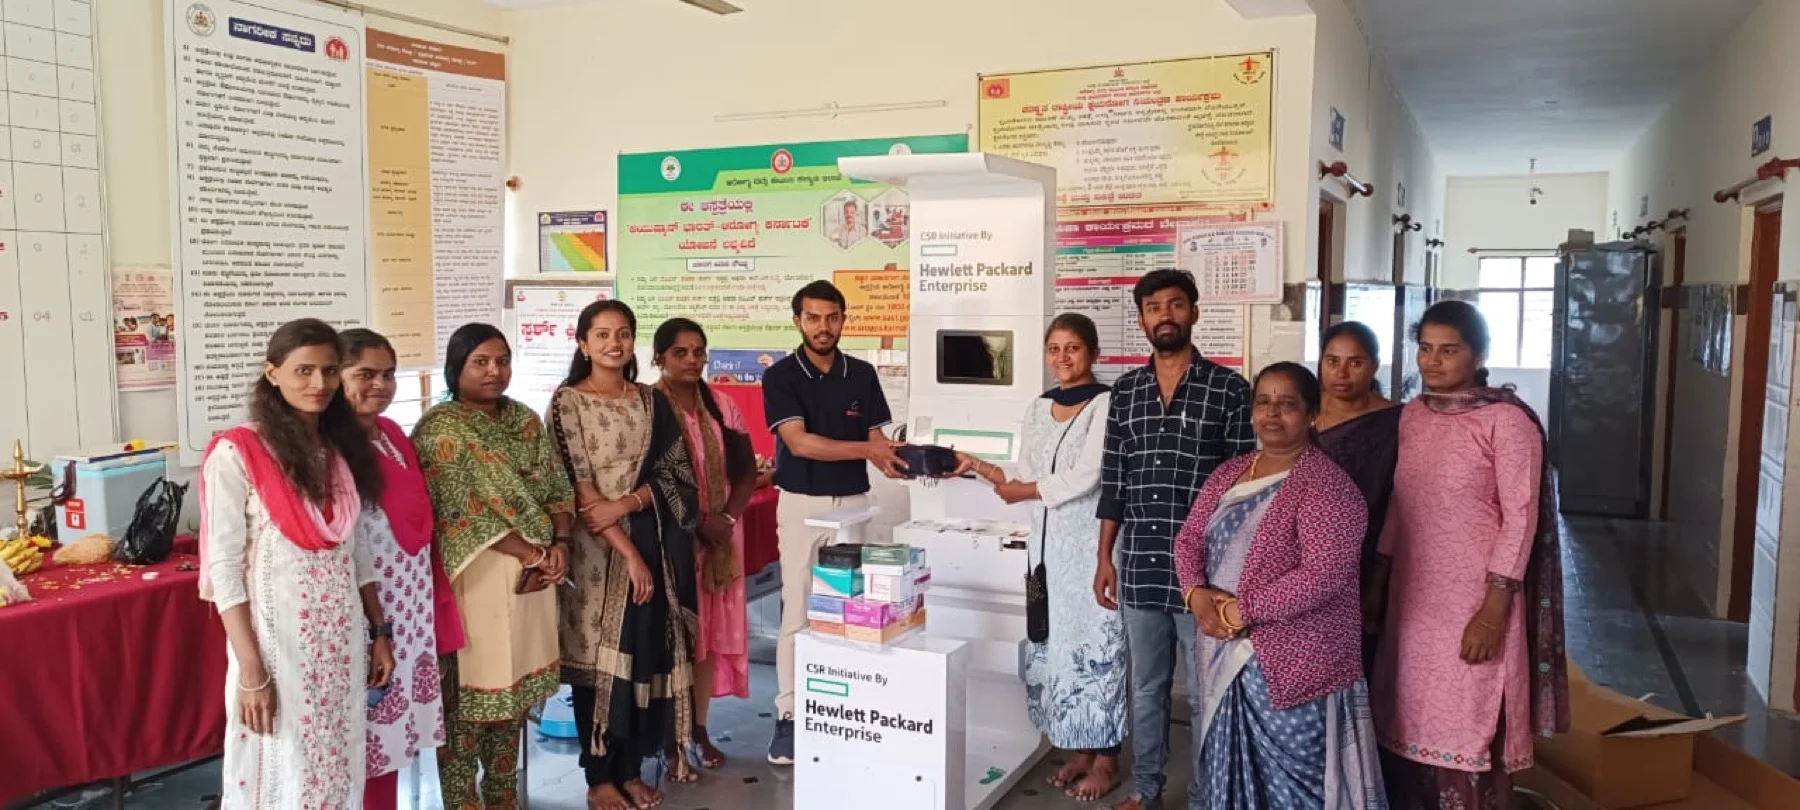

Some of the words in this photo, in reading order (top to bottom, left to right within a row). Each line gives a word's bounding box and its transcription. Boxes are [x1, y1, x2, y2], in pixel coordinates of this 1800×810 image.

[700, 198, 753, 216] ಆಸ್ಪತ್ರೆಯಲ್ಲಿ
[920, 231, 937, 241] CSR
[939, 230, 979, 240] Initiative
[981, 230, 992, 241] By
[920, 263, 973, 277] Hewlett
[977, 261, 1032, 276] Packard
[920, 278, 988, 294] Enterprise
[806, 663, 825, 675] CSR
[828, 666, 873, 682] Initiative
[875, 673, 888, 686] By
[805, 699, 866, 723] Hewlett
[870, 710, 933, 734] Packard
[805, 718, 883, 743] Enterprise
